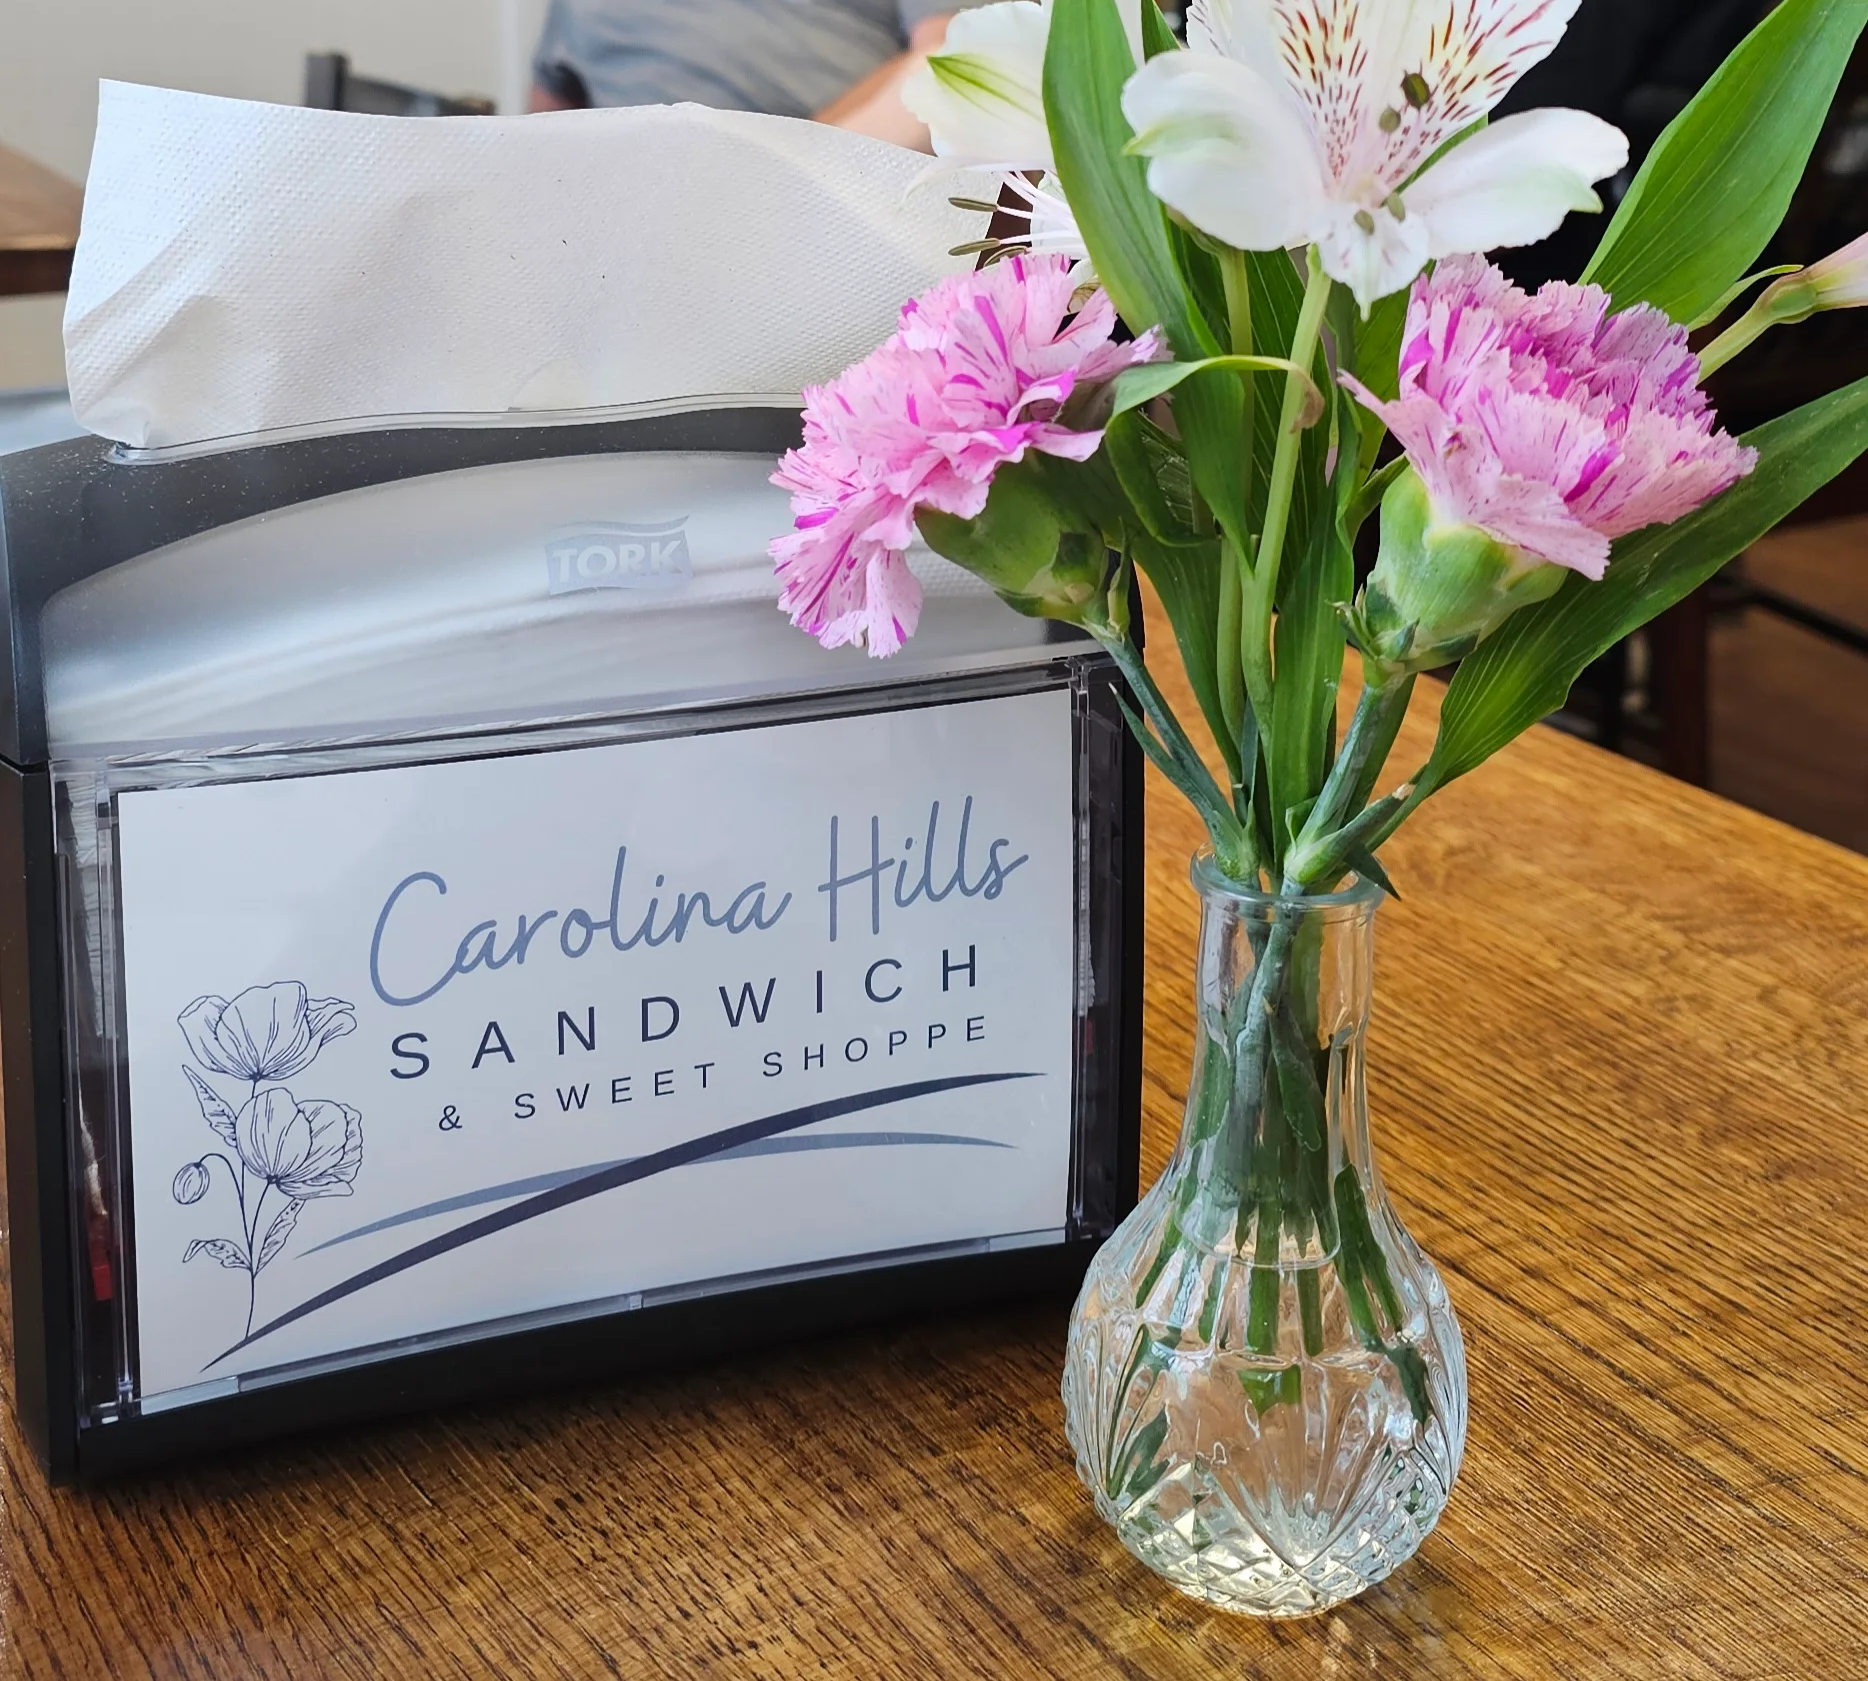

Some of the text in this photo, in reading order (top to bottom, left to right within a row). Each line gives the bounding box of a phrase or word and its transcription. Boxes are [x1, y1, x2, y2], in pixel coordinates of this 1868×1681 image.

[551, 538, 684, 583] TORK
[368, 794, 1030, 1008] Carolina Hills
[388, 943, 977, 1081] SANDWICH
[437, 1014, 987, 1132] & SWEET SHOPPE
